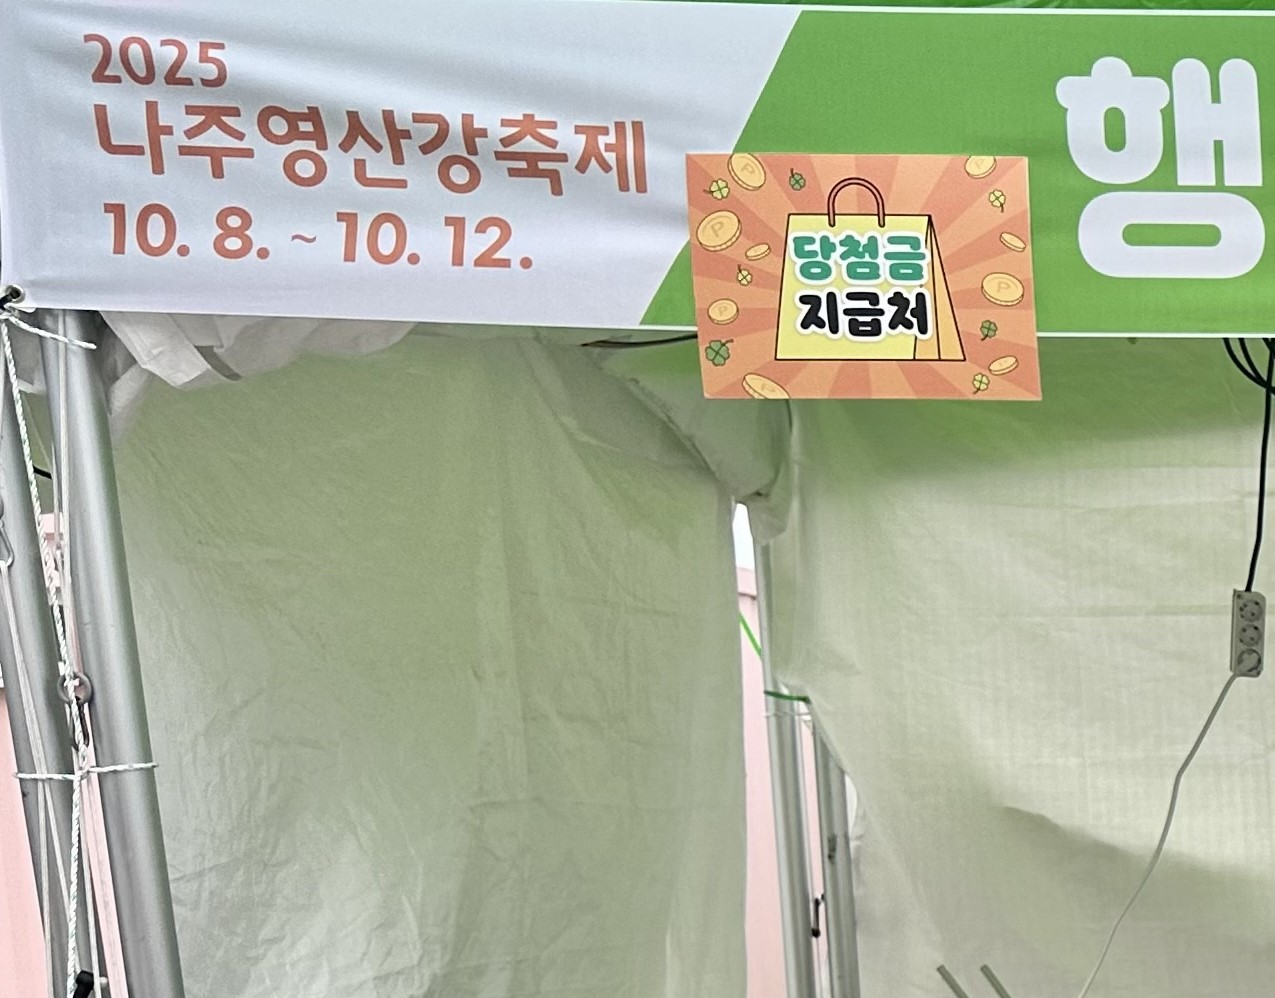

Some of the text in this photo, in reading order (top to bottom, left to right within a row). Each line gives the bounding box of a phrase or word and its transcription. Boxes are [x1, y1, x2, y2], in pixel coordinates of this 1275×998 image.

[84, 33, 229, 88] 2025
[92, 100, 648, 196] 나주영산강축제
[103, 203, 190, 258] 10.
[212, 206, 271, 261] 8.
[337, 212, 420, 267] 10.
[443, 216, 534, 271] 12.
[792, 233, 929, 283] 당첨금
[797, 289, 931, 338] 지급처
